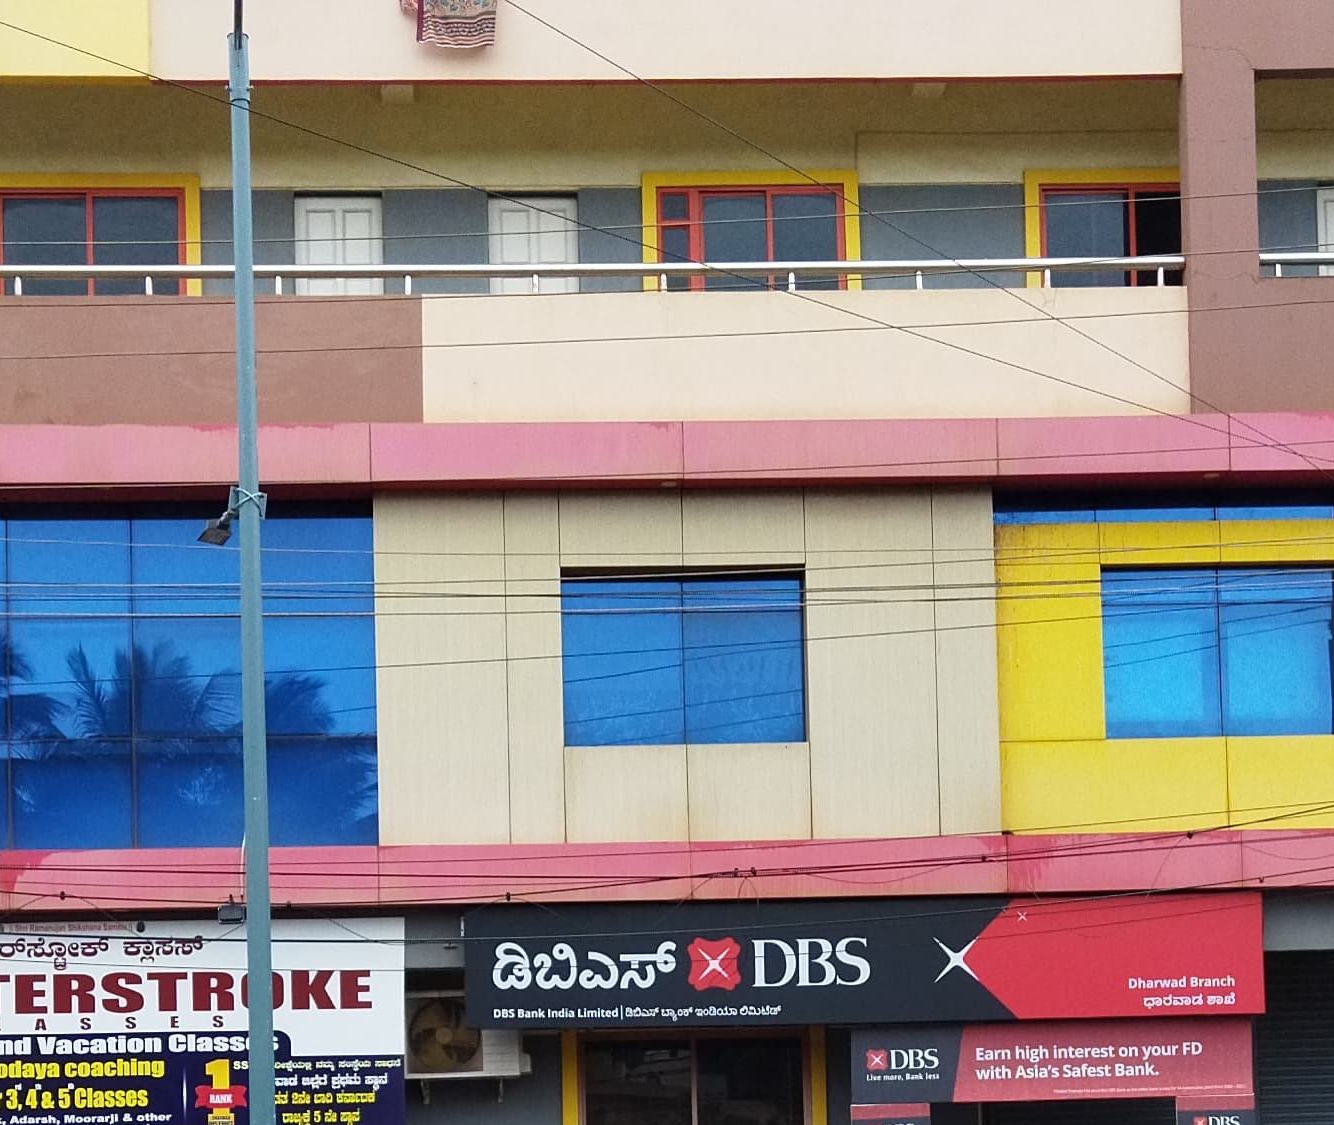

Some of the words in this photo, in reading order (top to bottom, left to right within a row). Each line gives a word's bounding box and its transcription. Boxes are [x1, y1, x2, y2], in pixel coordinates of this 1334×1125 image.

[492, 941, 676, 990] ಡಿಬಿಎಸ್
[752, 936, 871, 987] DBS
[1128, 976, 1186, 989] Dharwad
[1190, 975, 1235, 987] Branch
[1143, 993, 1203, 1009] ಧಾರವಾಡ
[494, 1009, 515, 1018] DBS
[517, 1009, 545, 1018] Bank
[548, 1009, 575, 1018] India
[577, 1008, 618, 1018] Limited
[39, 1034, 163, 1056] Vacation
[975, 1047, 1011, 1061] Earn
[1014, 1045, 1049, 1066] high
[1052, 1042, 1115, 1059] interest
[1119, 1045, 1140, 1057] on
[1142, 1045, 1179, 1061] your
[1182, 1042, 1203, 1055] FD
[890, 1048, 939, 1070] DBS
[65, 1059, 165, 1078] coaching
[975, 1064, 1012, 1080] with
[1063, 1063, 1111, 1078] Safest
[1115, 1062, 1159, 1076] Bank.
[41, 1091, 55, 1109] &
[75, 1088, 149, 1108] Classes
[209, 1094, 233, 1103] RANK
[123, 1114, 132, 1122] &
[136, 1113, 172, 1122] other
[314, 1111, 321, 1122] 5
